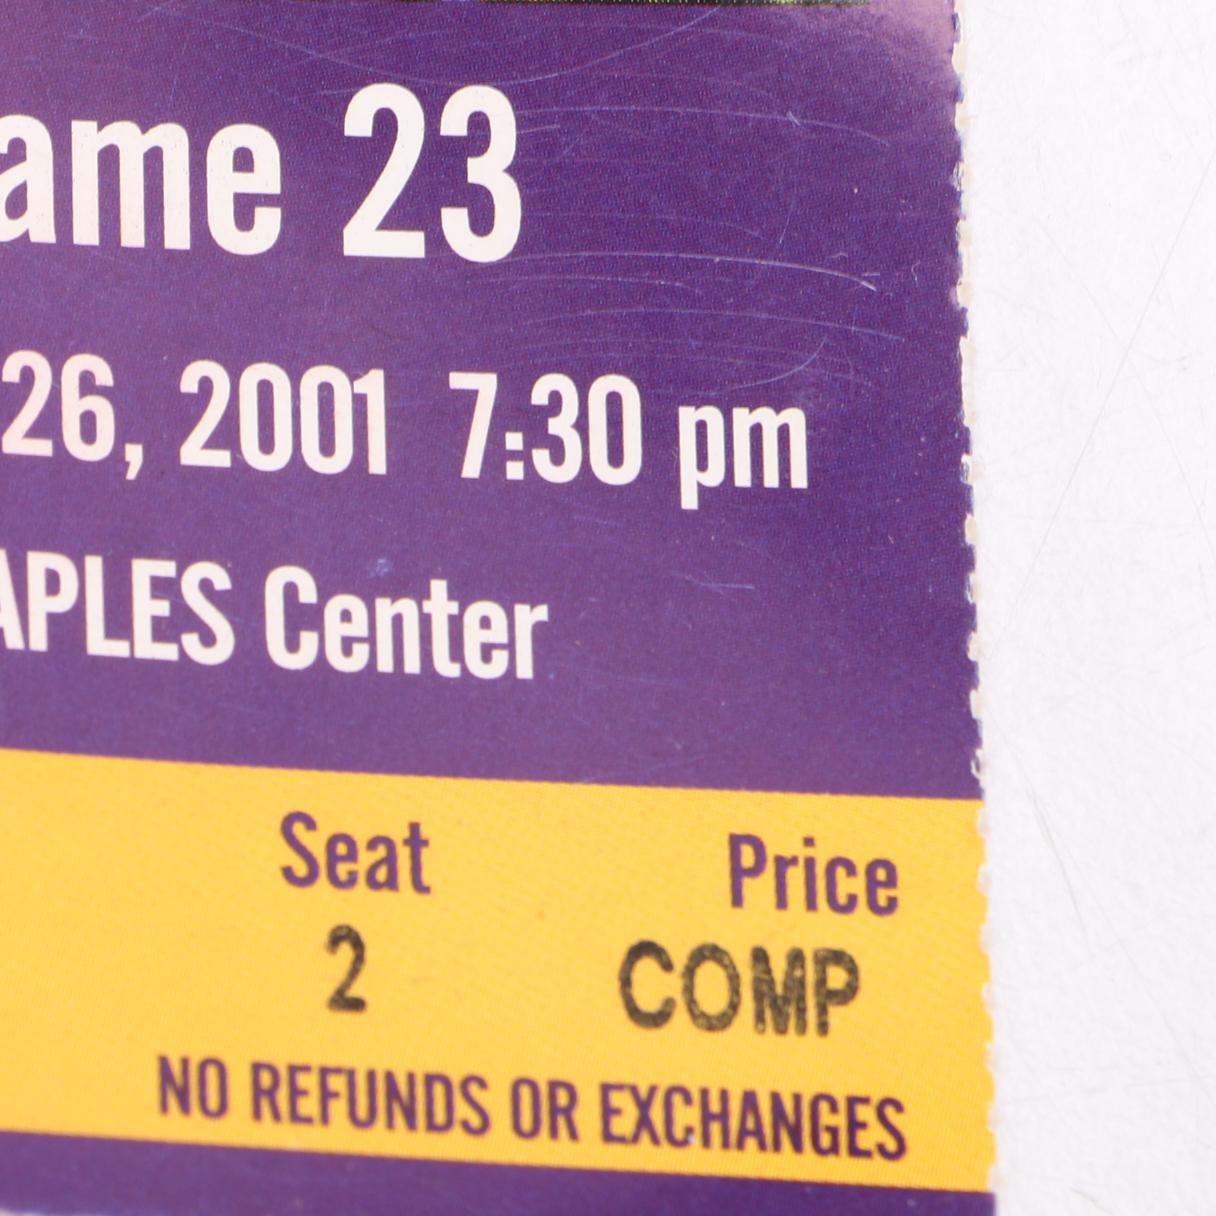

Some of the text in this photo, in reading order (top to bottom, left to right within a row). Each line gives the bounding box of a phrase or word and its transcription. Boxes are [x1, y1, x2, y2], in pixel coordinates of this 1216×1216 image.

[342, 82, 523, 263] 23
[1, 350, 145, 480] 26,
[179, 359, 388, 476] 2001
[448, 371, 644, 487] 7:30
[678, 404, 810, 511] pm
[264, 565, 551, 681] Center
[280, 811, 431, 895] Seat
[728, 833, 899, 917] Price
[325, 925, 368, 1013] 2
[618, 940, 861, 1036] COMP
[158, 1055, 907, 1162] NO REFUNDS OR EXCHANGES
